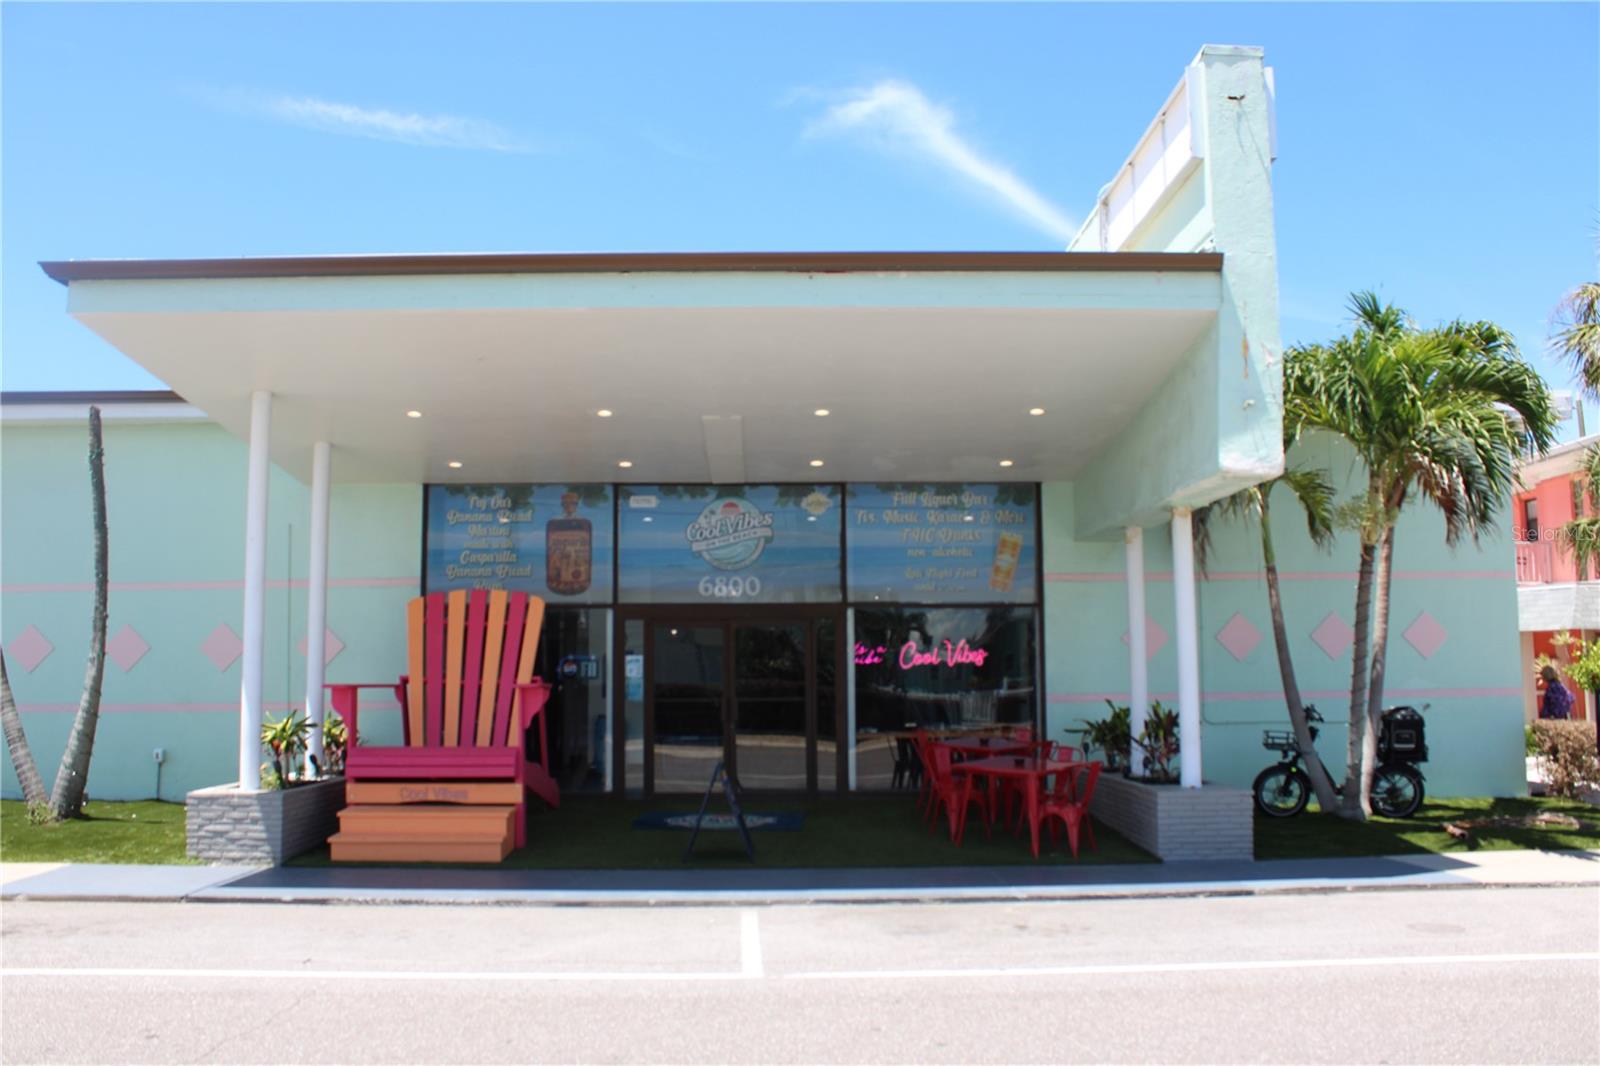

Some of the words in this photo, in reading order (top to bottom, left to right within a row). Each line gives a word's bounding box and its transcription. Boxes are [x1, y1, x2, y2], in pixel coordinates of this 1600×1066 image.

[686, 519, 724, 543] Cool
[723, 512, 774, 536] Vibes
[698, 576, 761, 597] 6800
[898, 640, 942, 670] Cool
[943, 638, 989, 668] Vibes
[399, 786, 430, 800] Cool
[433, 786, 469, 800] Vibes
